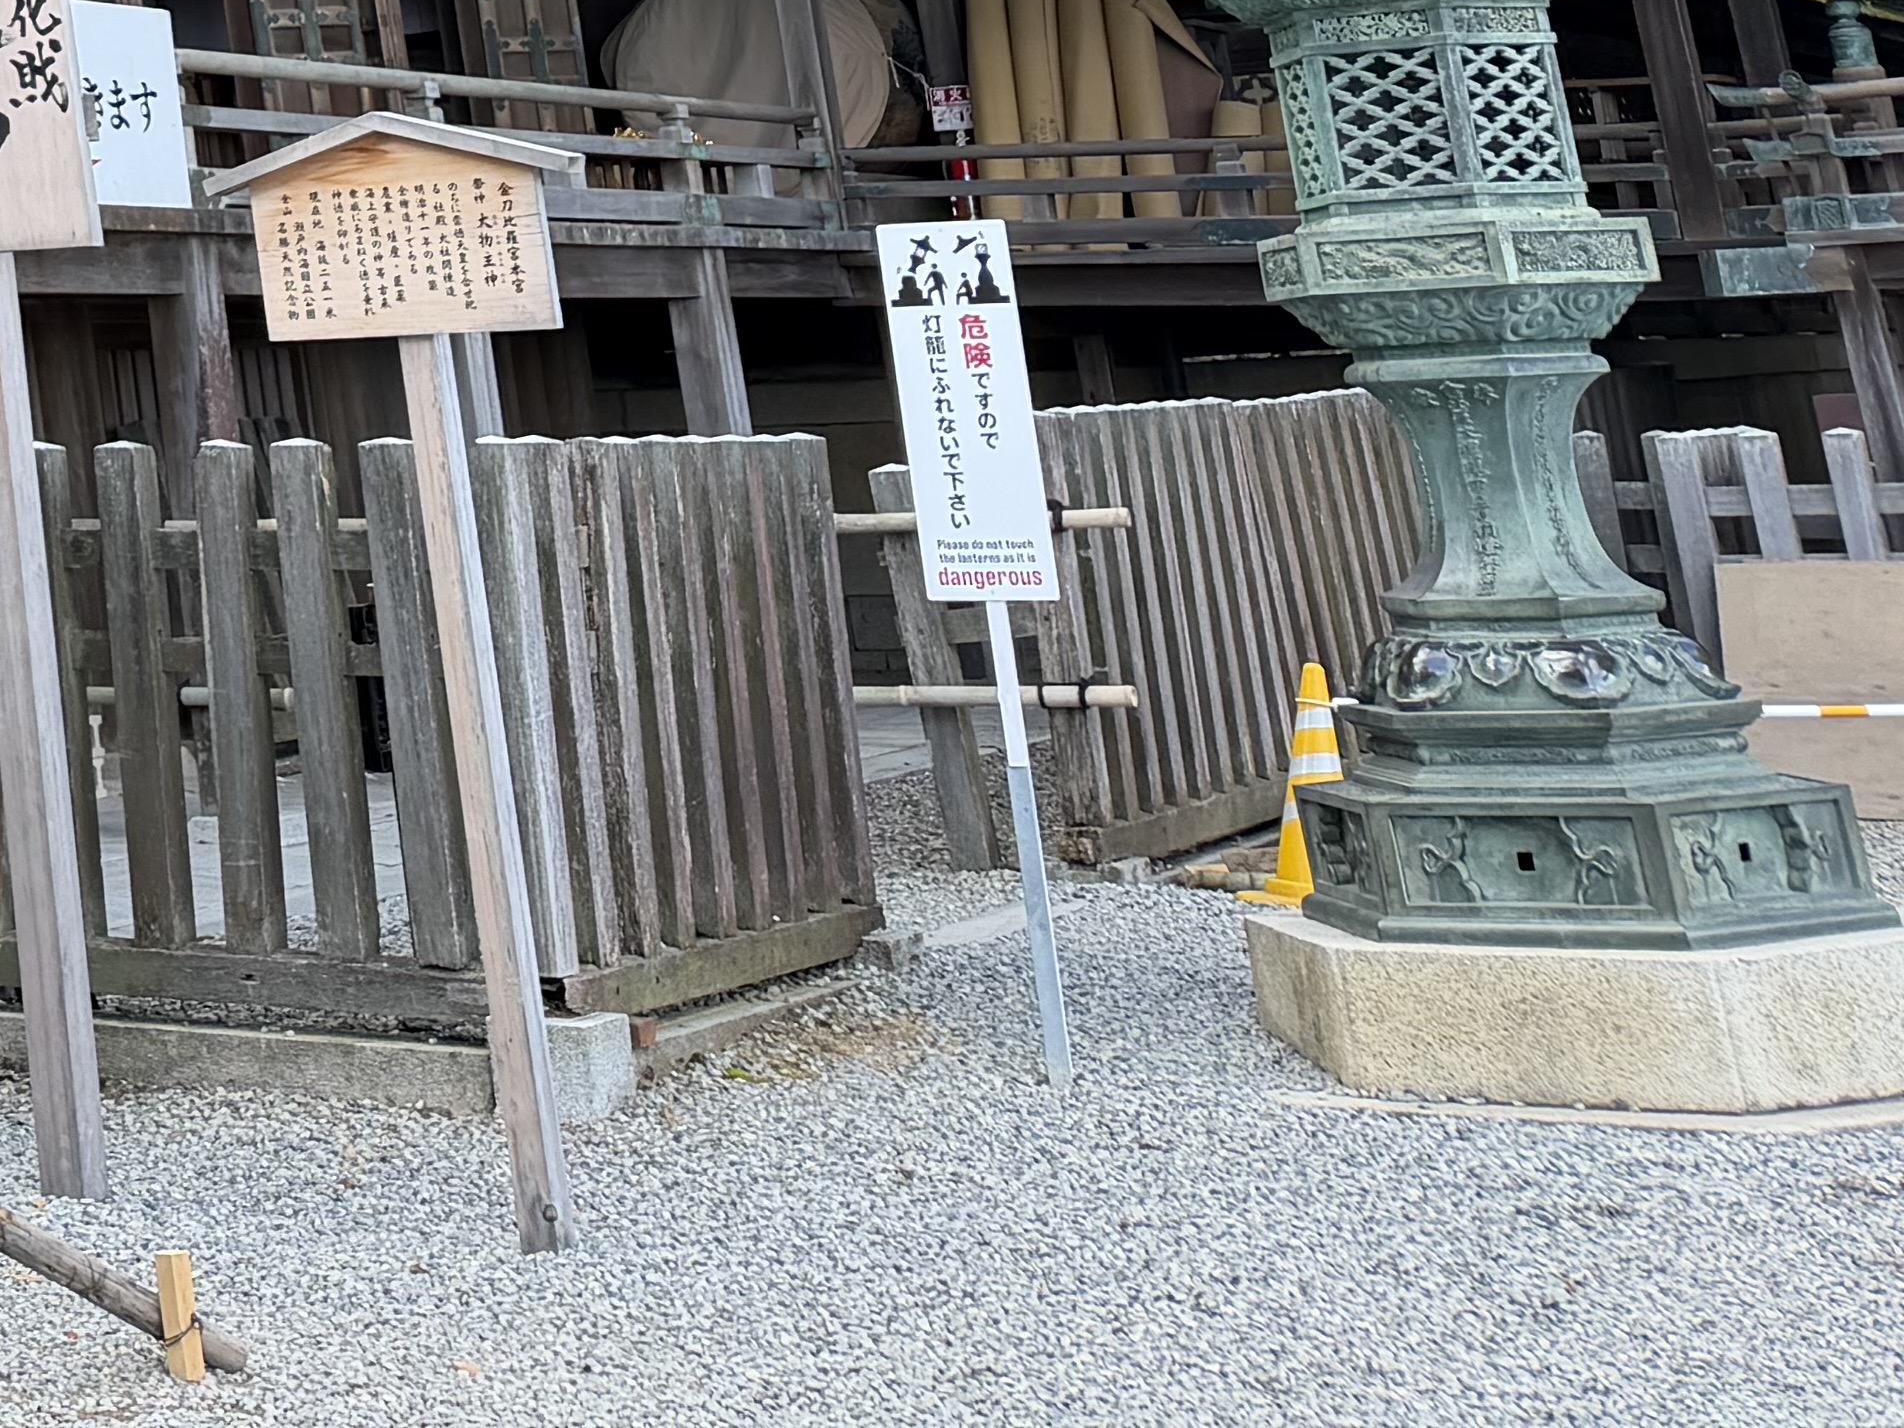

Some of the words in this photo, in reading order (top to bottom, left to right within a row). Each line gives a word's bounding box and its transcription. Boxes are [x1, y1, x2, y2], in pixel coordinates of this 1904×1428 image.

[933, 87, 970, 104] 消火
[497, 182, 525, 293] 金刀比羅宮本宮
[477, 213, 498, 287] 大物主神
[958, 313, 1000, 450] 危険ですので
[937, 539, 969, 550] Please
[972, 539, 983, 549] do
[986, 540, 1003, 550] not
[1006, 538, 1034, 549] touch
[939, 554, 955, 563] the
[1003, 554, 1015, 563] as
[1016, 552, 1025, 563] it
[1027, 552, 1036, 563] is
[938, 566, 1043, 589] dangerous
